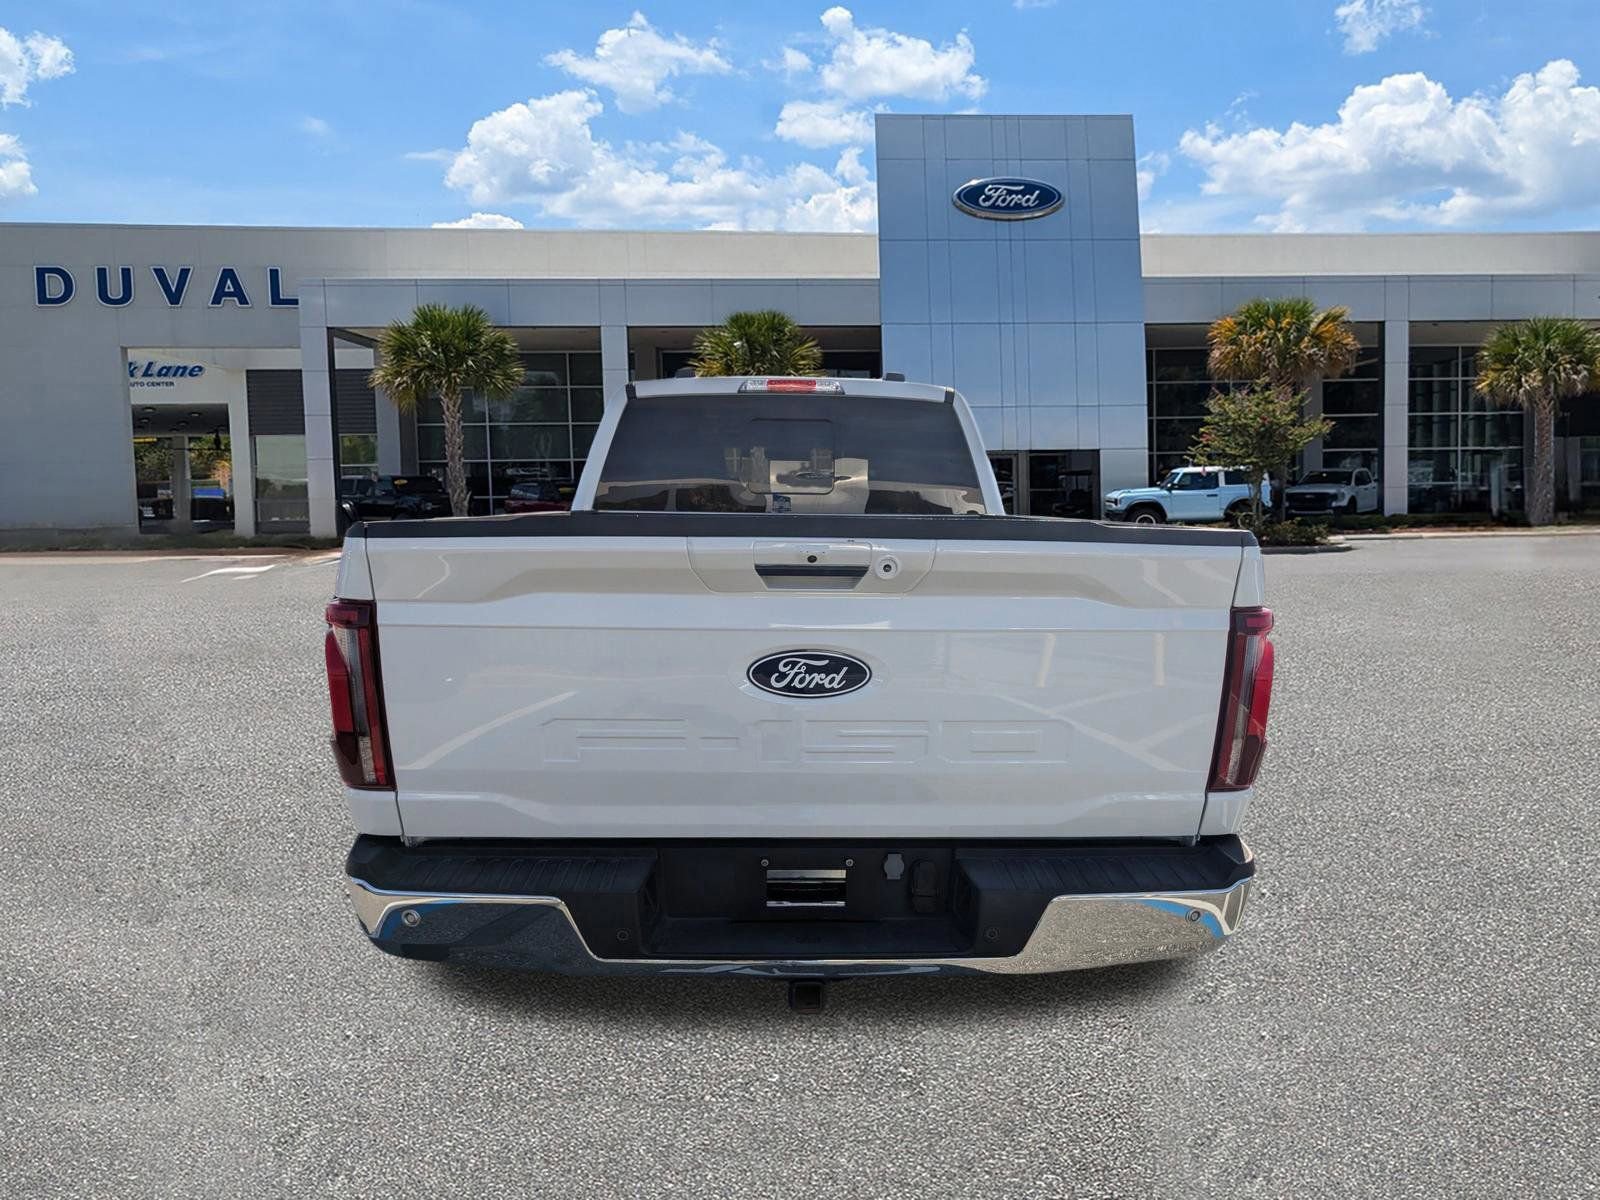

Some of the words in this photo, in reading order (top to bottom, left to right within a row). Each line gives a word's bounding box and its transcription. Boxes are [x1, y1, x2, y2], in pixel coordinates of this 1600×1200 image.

[979, 184, 1040, 208] Ford
[34, 265, 299, 307] DUVAL
[142, 361, 204, 378] Lane
[770, 657, 849, 689] Ford
[538, 717, 1073, 766] F-150
